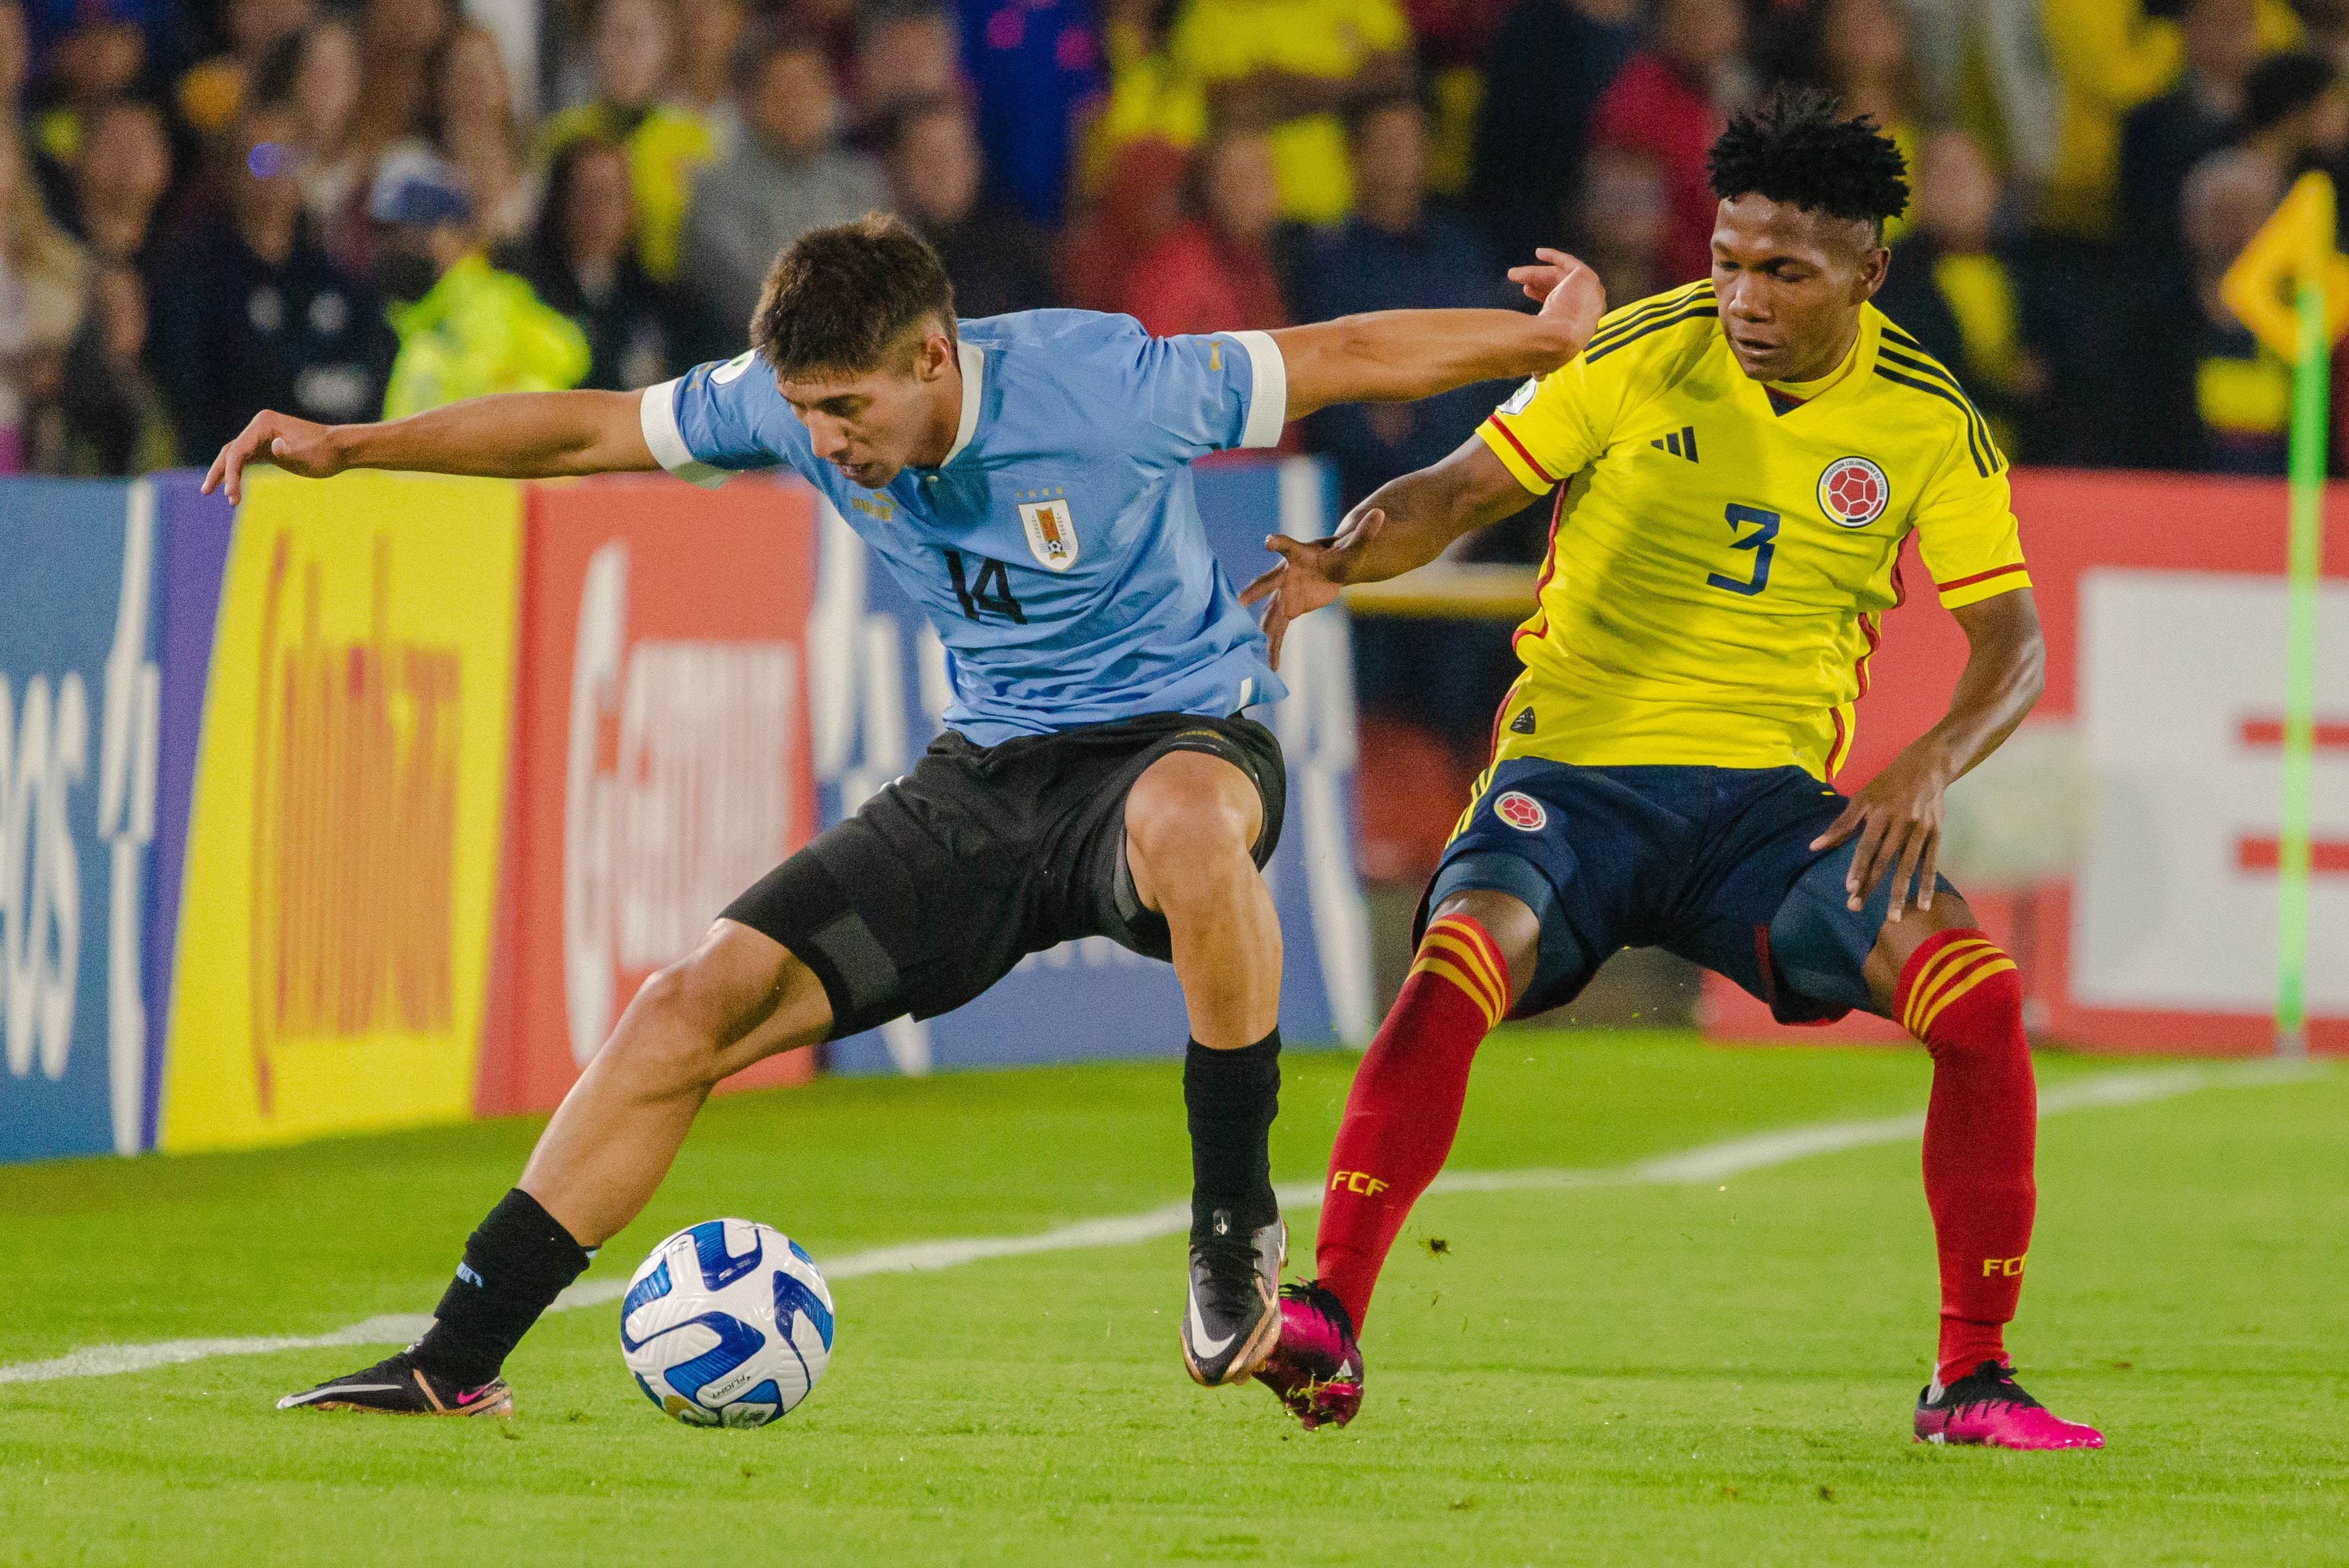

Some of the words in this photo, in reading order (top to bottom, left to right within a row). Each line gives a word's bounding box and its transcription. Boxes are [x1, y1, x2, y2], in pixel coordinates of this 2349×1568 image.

[1845, 460, 1877, 473] COLOMBIANA
[1706, 503, 1780, 596] 3
[943, 550, 1028, 626] 14
[1331, 1171, 1390, 1197] FCF
[712, 1375, 745, 1398] FLIGHT
